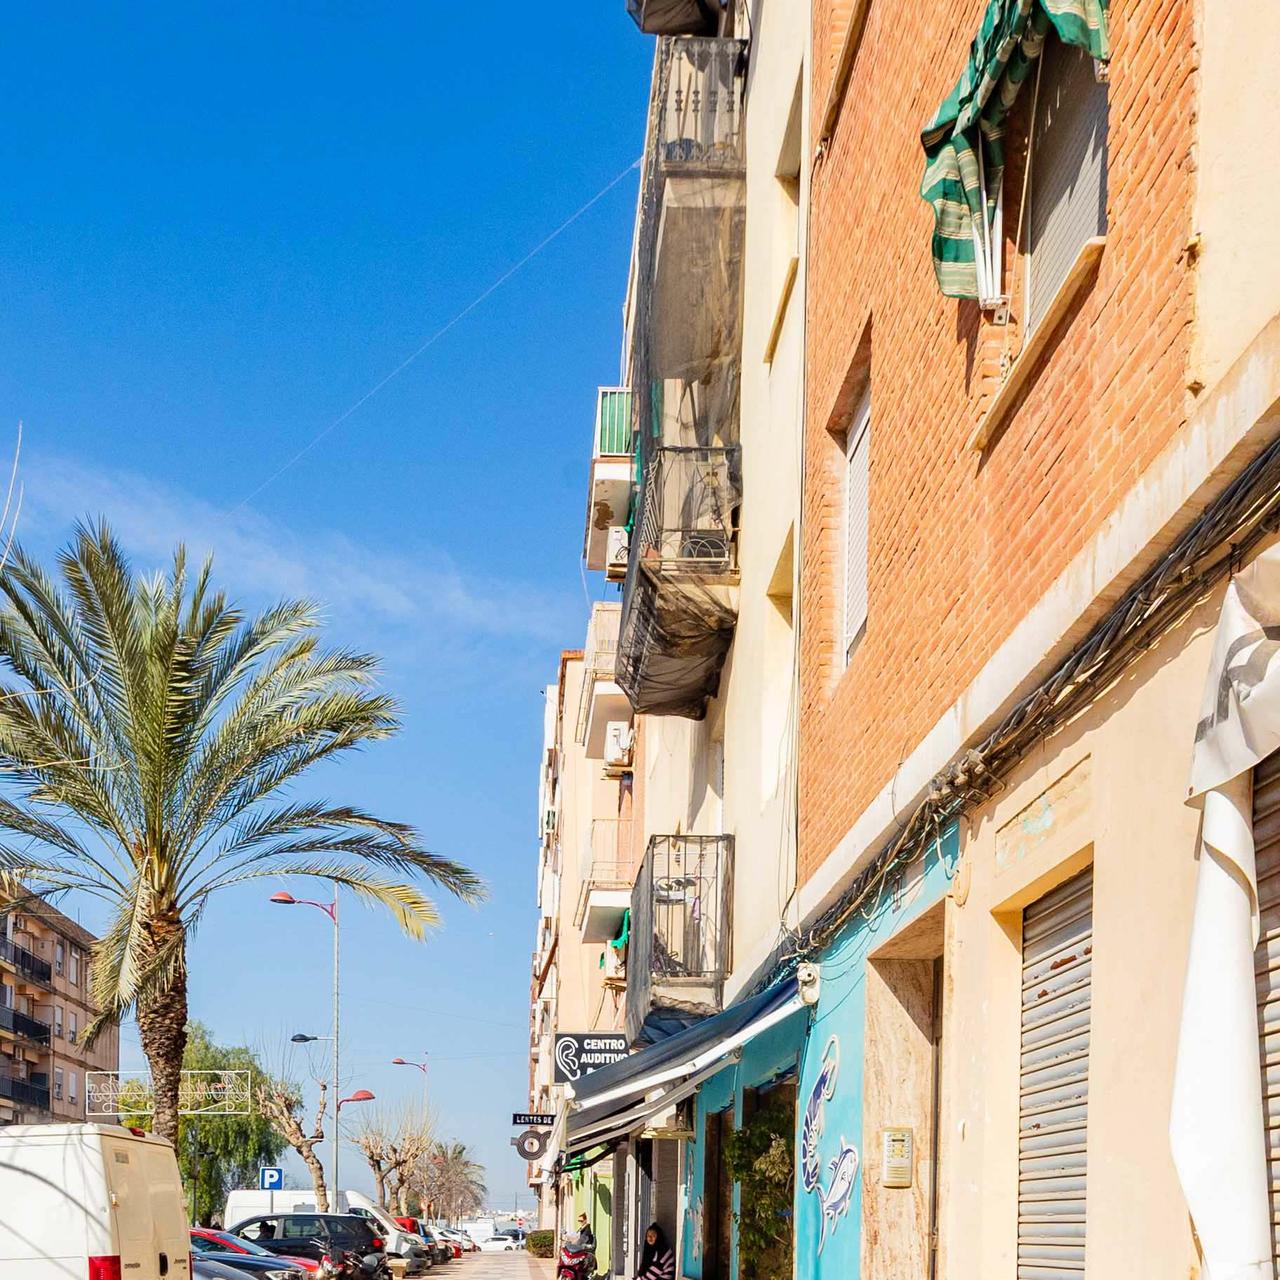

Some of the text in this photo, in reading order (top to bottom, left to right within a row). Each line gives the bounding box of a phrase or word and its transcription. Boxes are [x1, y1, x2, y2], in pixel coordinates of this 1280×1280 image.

[584, 1039, 626, 1050] CENTRO
[516, 1116, 552, 1124] LENTES DE
[264, 1169, 280, 1189] P
